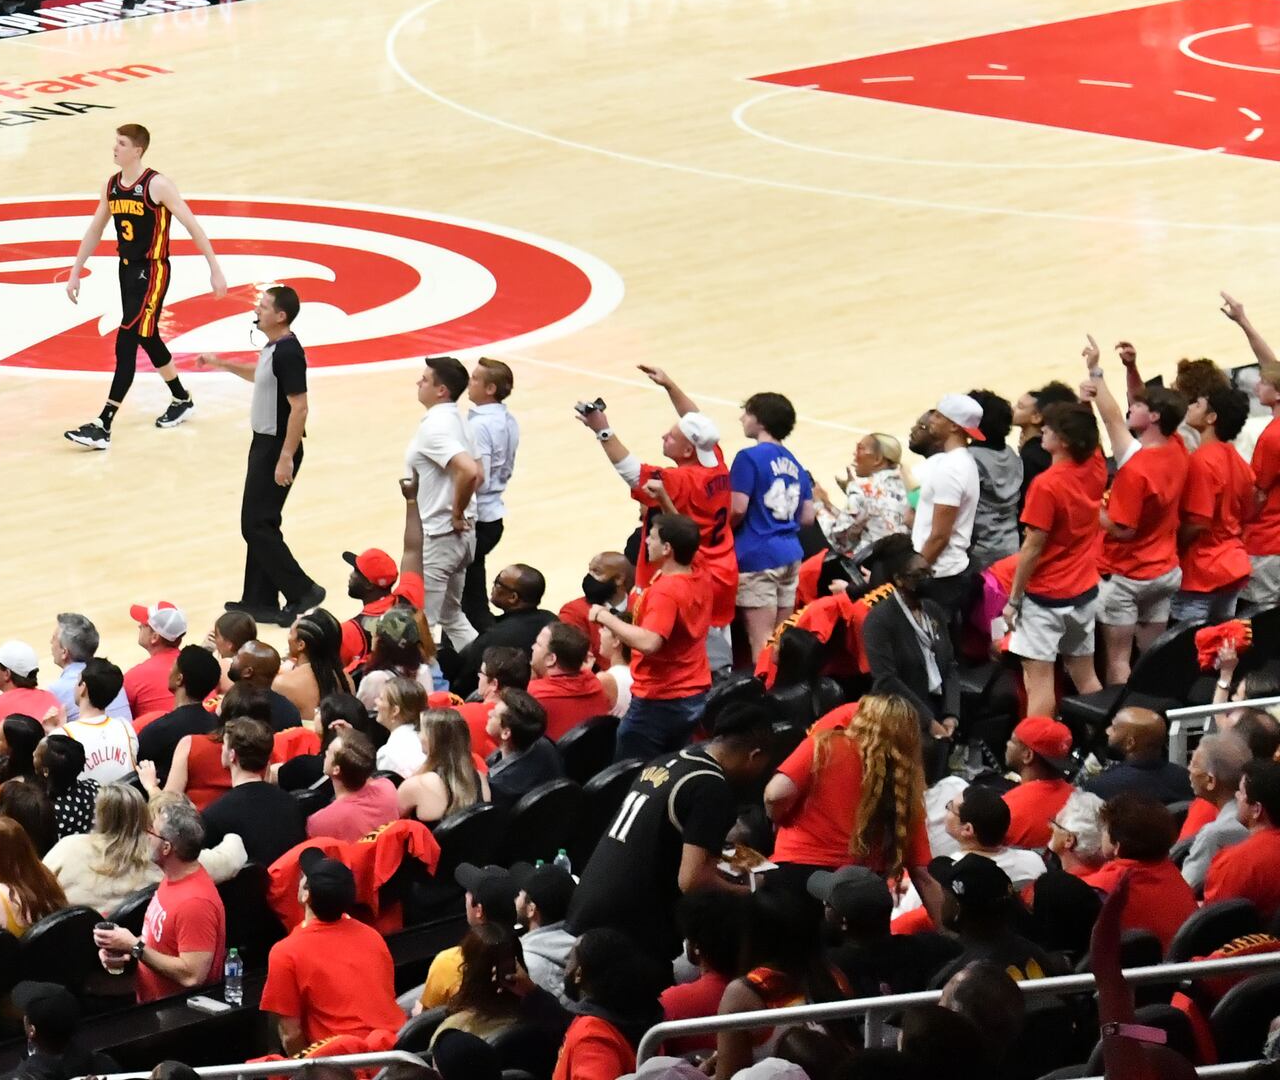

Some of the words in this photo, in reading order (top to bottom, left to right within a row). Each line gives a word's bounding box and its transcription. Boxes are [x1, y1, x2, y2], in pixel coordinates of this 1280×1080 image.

[108, 199, 145, 217] HAWKS
[121, 220, 135, 241] 3
[85, 744, 128, 770] COLLINS
[607, 789, 650, 843] 11
